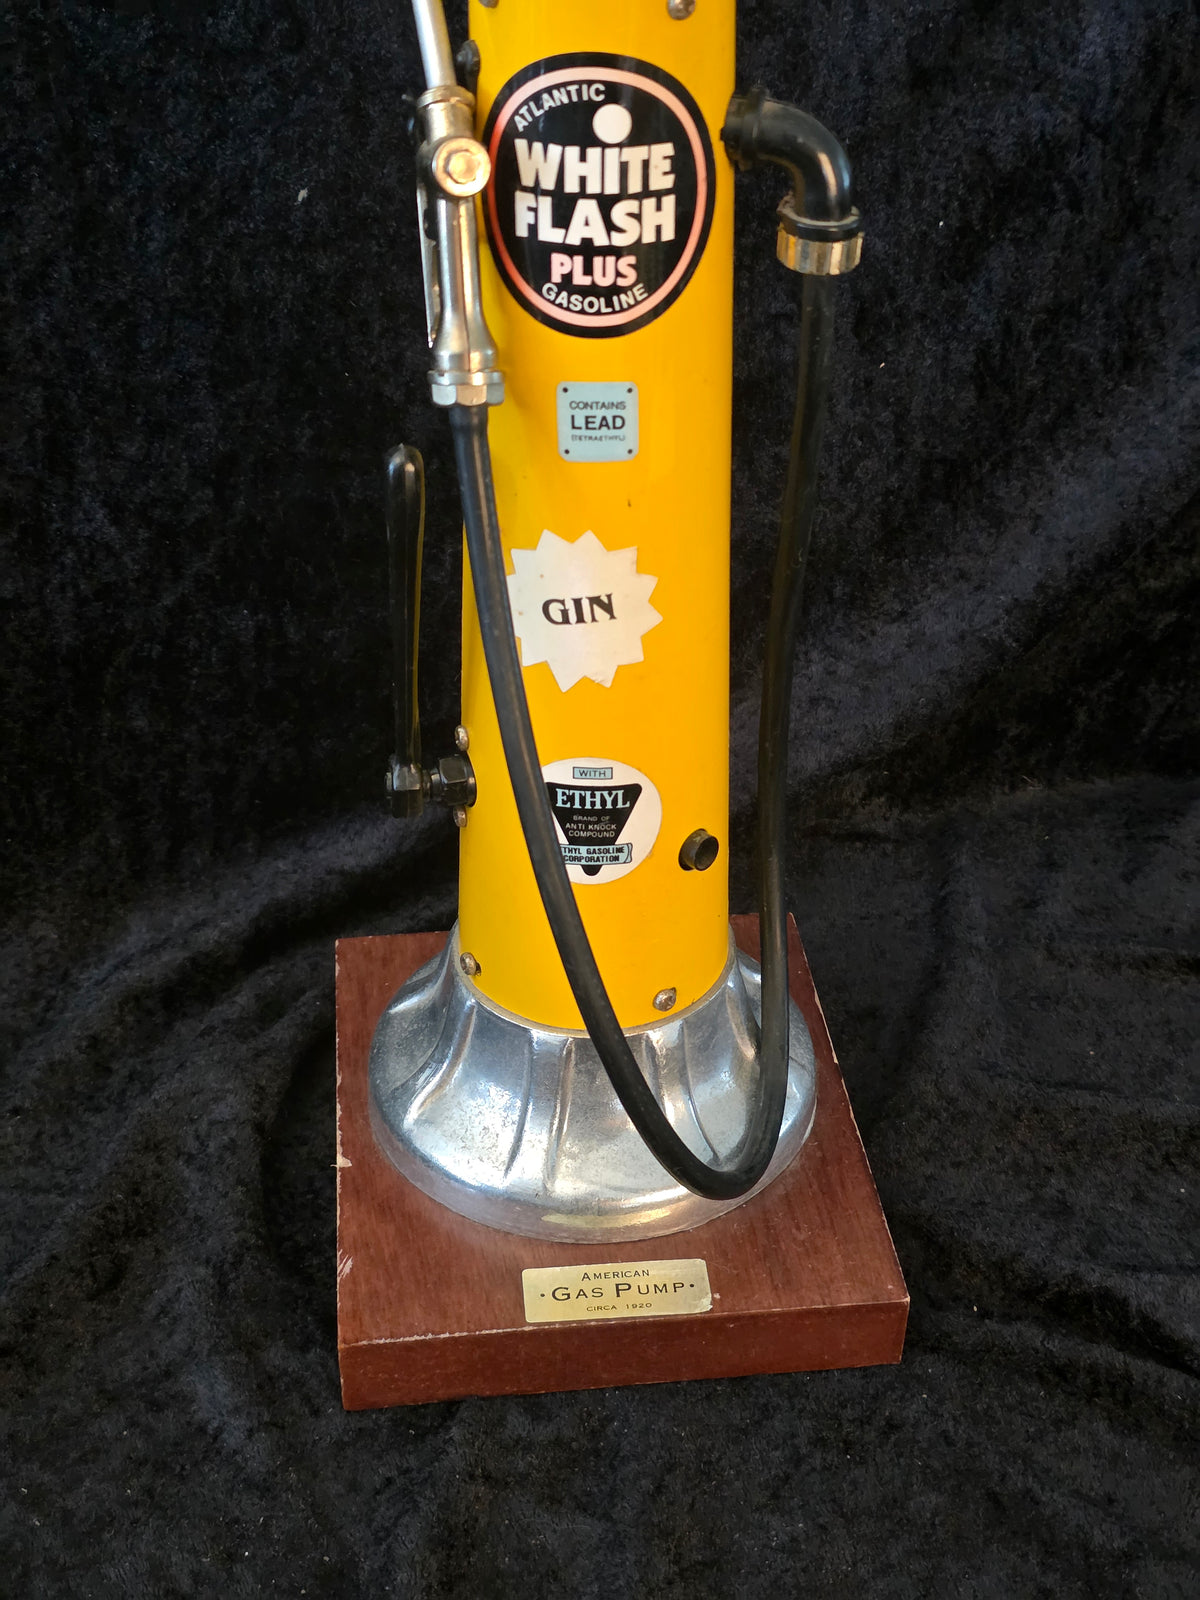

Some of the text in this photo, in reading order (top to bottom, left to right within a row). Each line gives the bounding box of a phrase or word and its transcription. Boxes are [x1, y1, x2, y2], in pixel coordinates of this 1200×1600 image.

[513, 83, 605, 132] ATLANTIC
[514, 138, 676, 195] WHITE
[514, 190, 676, 247] FLASH
[550, 252, 638, 287] PLUS
[541, 283, 649, 313] GASOLINE
[569, 400, 626, 410] CONTAINS
[571, 414, 626, 430] LEAD
[541, 593, 617, 625] GIN
[578, 769, 607, 778] WITH
[555, 788, 631, 809] ETHYL
[565, 822, 617, 831] ANTI KNOCK
[568, 830, 616, 838] COMPOUND
[561, 846, 626, 855] THYL GASOLINE
[625, 1302, 653, 1310] 1920
